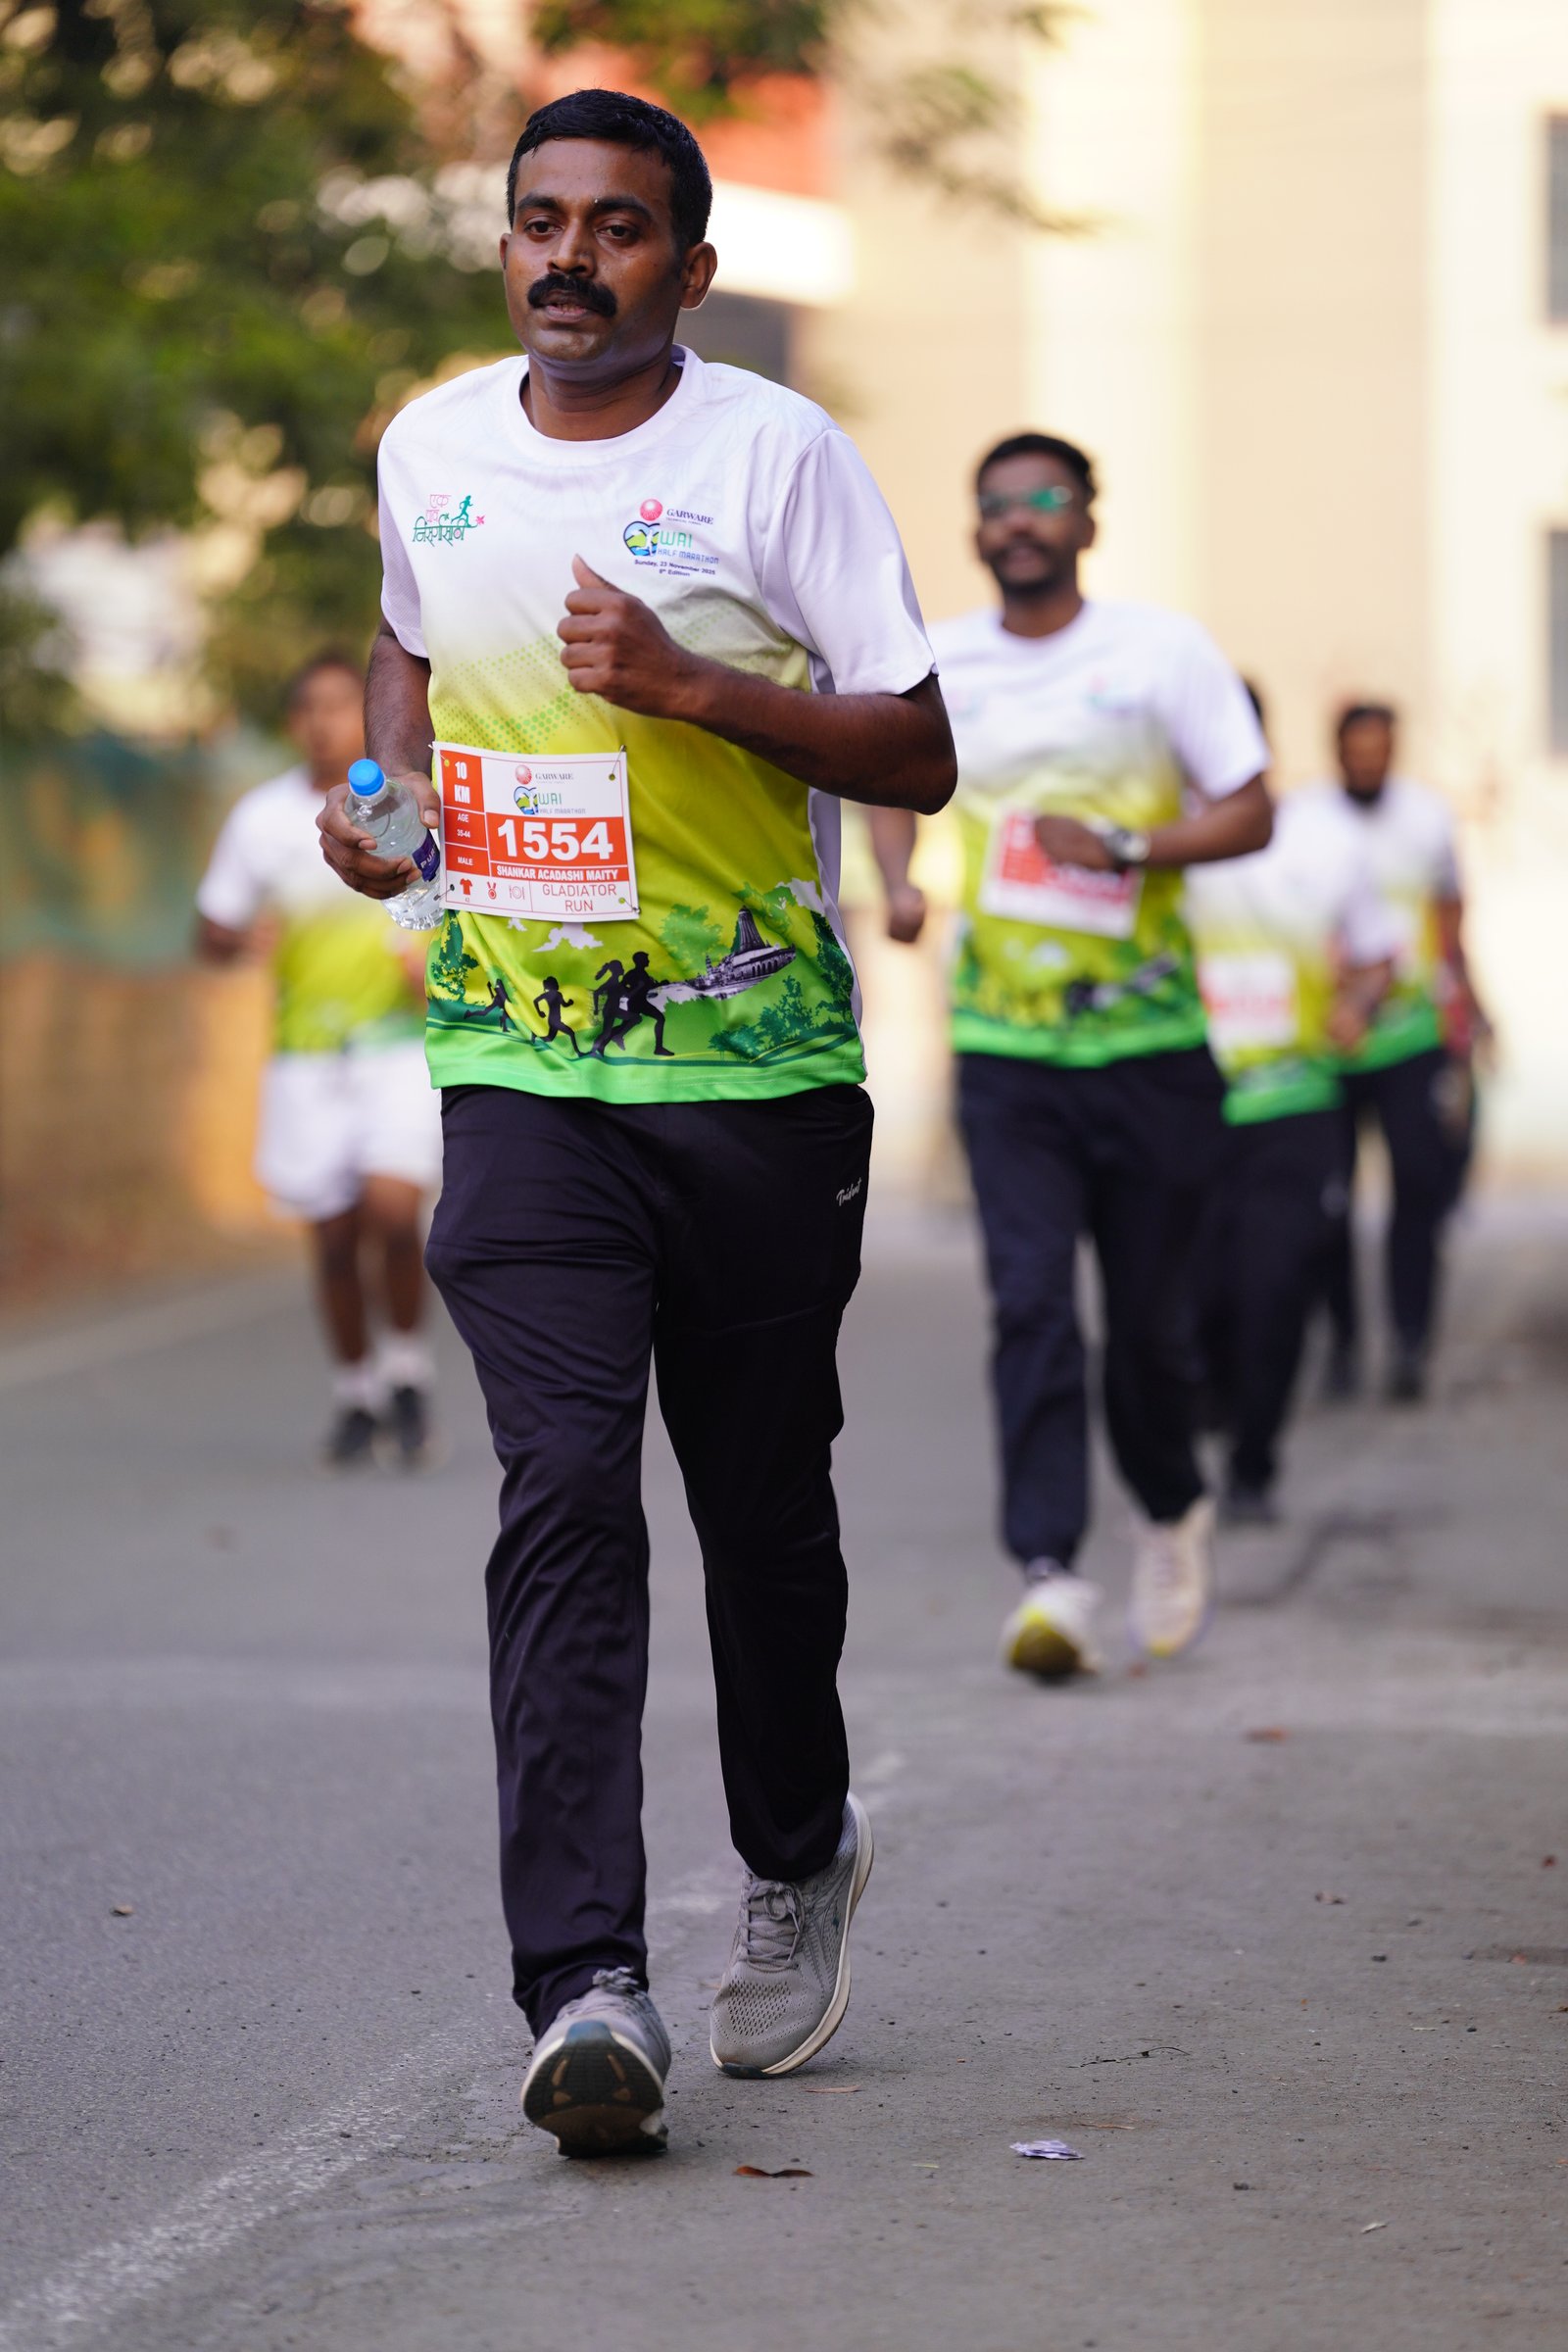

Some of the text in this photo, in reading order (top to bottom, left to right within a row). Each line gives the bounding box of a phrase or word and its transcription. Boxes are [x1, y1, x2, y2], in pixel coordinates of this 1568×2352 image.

[666, 509, 714, 525] GARWARE
[660, 530, 693, 548] WAI
[658, 548, 719, 564] HALF MARATHON
[668, 563, 700, 572] November
[455, 761, 467, 781] 10
[535, 772, 574, 781] GARWARE
[454, 784, 470, 805] KM
[538, 792, 562, 806] WAI
[457, 812, 469, 823] AGE
[457, 828, 471, 839] 35-44
[497, 819, 613, 861] 1554
[457, 856, 473, 867] MALE
[496, 864, 618, 882] SHANKAR ACADASHI MAITY
[542, 883, 617, 898] GLADIATOR
[565, 900, 594, 912] RUN
